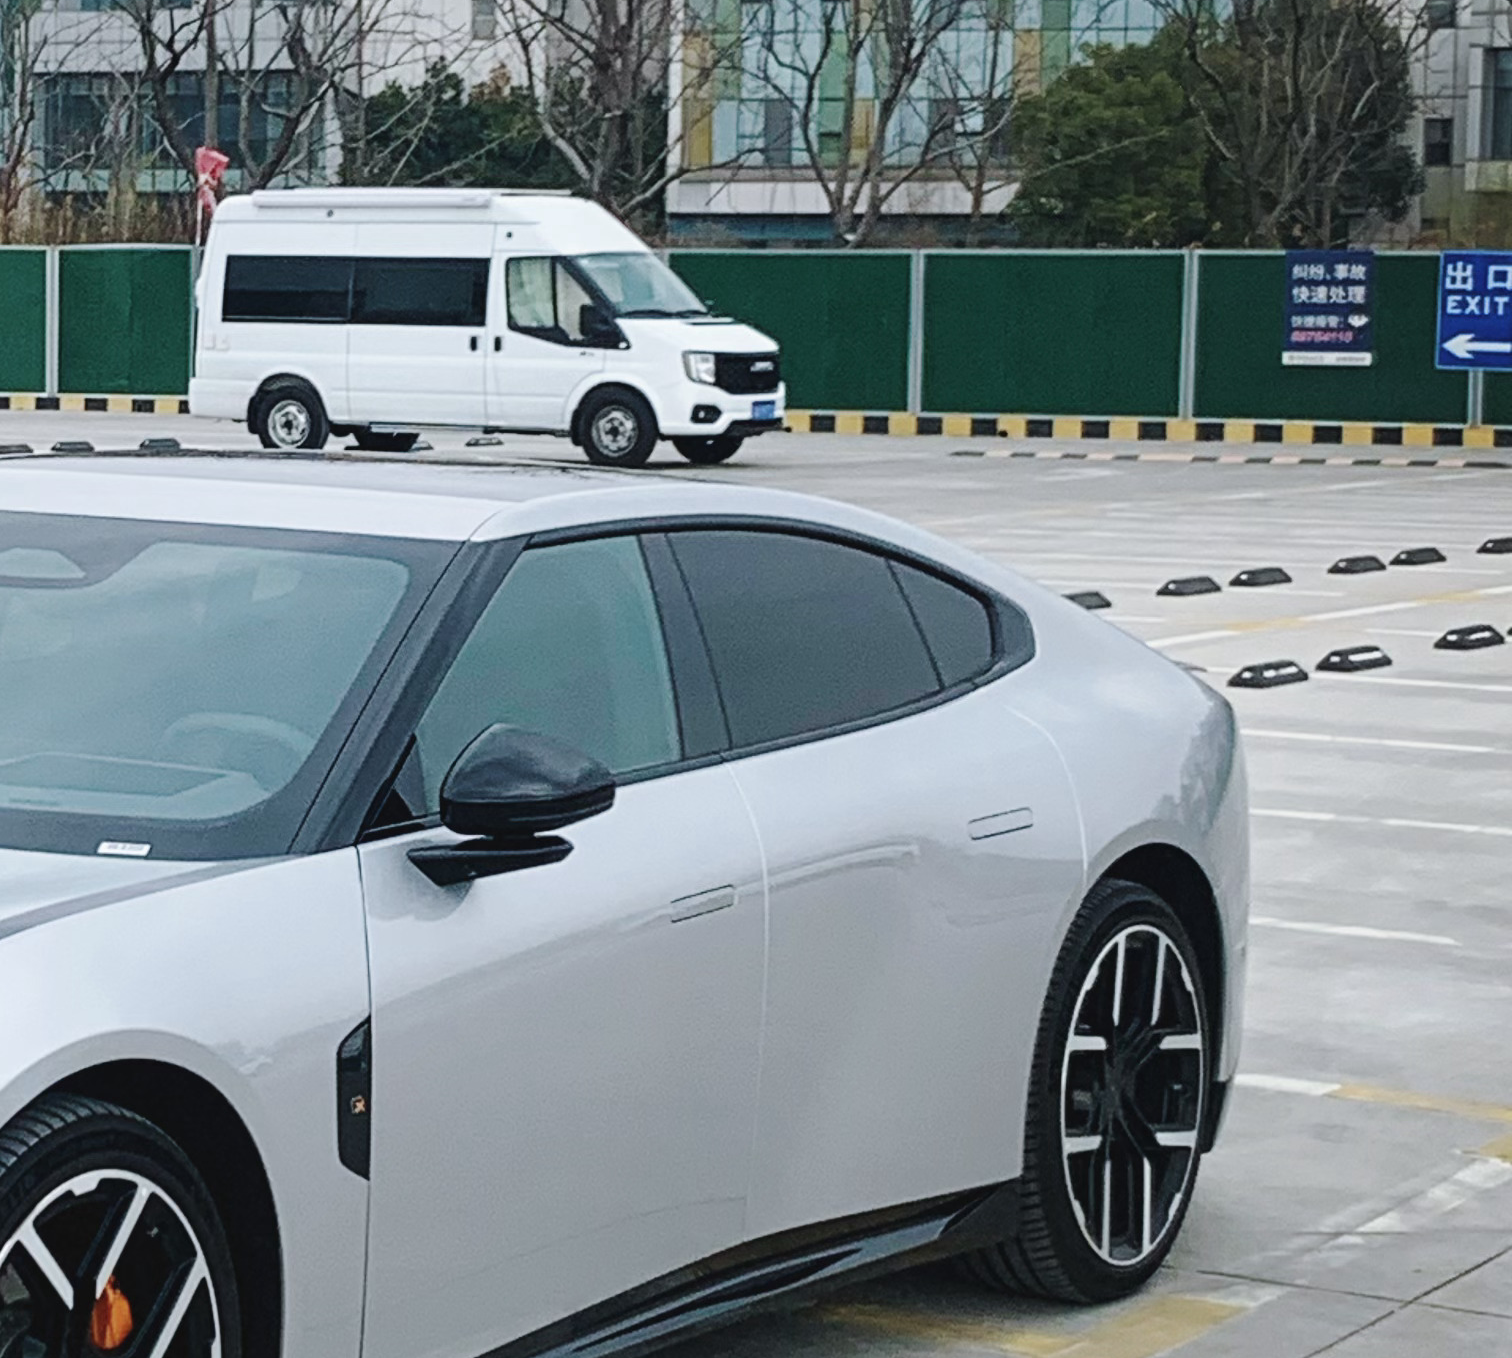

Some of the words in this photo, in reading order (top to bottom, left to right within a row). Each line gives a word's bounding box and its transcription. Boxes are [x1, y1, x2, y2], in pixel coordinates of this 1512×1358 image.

[1445, 260, 1512, 291] 出口
[1292, 285, 1366, 304] 快速处理
[1445, 295, 1509, 316] EXIT
